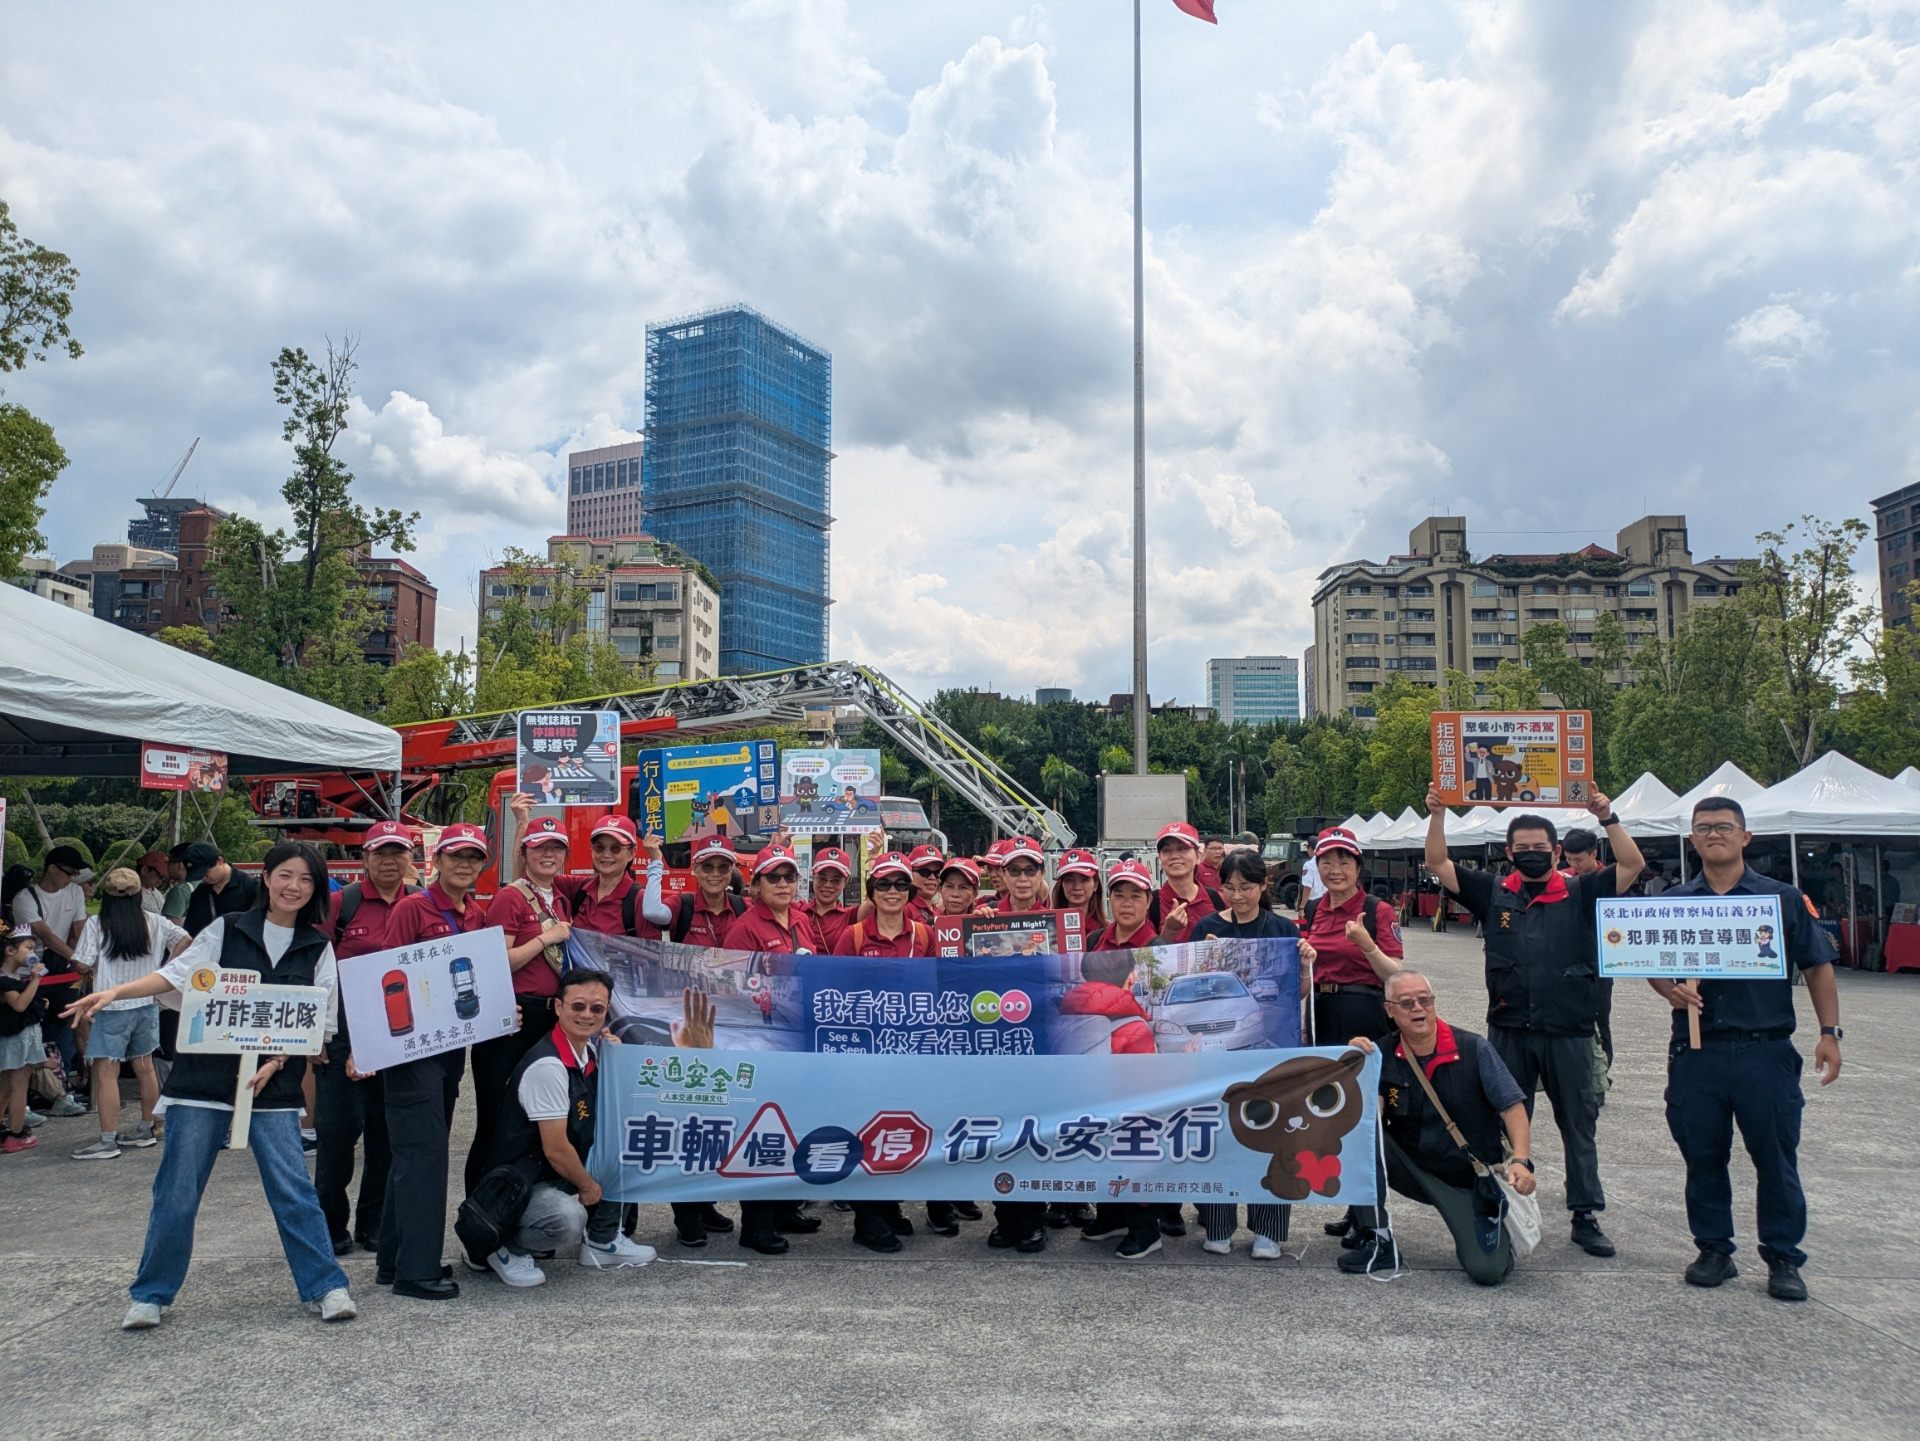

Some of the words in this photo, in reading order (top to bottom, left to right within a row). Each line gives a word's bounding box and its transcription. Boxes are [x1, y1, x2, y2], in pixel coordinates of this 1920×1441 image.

[526, 715, 581, 726] 無號誌路口
[1465, 721, 1554, 733] 聚餐小酌不酒駕
[533, 739, 577, 752] 要遵守
[1437, 722, 1457, 791] 拒絕酒駕
[643, 761, 662, 830] 行人優先
[1603, 905, 1774, 919] 臺北市政府警察局信義分局
[938, 928, 961, 942] NO
[972, 923, 1009, 932] PartyParty
[1010, 921, 1020, 929] All
[1022, 920, 1046, 929] Night?
[1627, 928, 1752, 946] 犯罪預防宣導團
[397, 943, 454, 965] 選擇在你
[205, 999, 318, 1029] 打詐臺北隊
[813, 988, 970, 1026] 我看得見您
[404, 1022, 474, 1051] 酒駕零容忍
[425, 1044, 443, 1054] DRINK
[445, 1040, 458, 1048] AND
[459, 1035, 476, 1044] DRIVE
[828, 1031, 848, 1042] See
[851, 1032, 861, 1043] &
[876, 1027, 1034, 1055] 您看得見我
[823, 1044, 837, 1054] Be
[840, 1045, 866, 1054] Seen
[638, 1056, 756, 1092] 交通安全月
[944, 1104, 1221, 1162] 行人安全行
[1020, 1180, 1097, 1192] 中華民國交通部
[1131, 1181, 1224, 1193] 臺北市政府交通局
